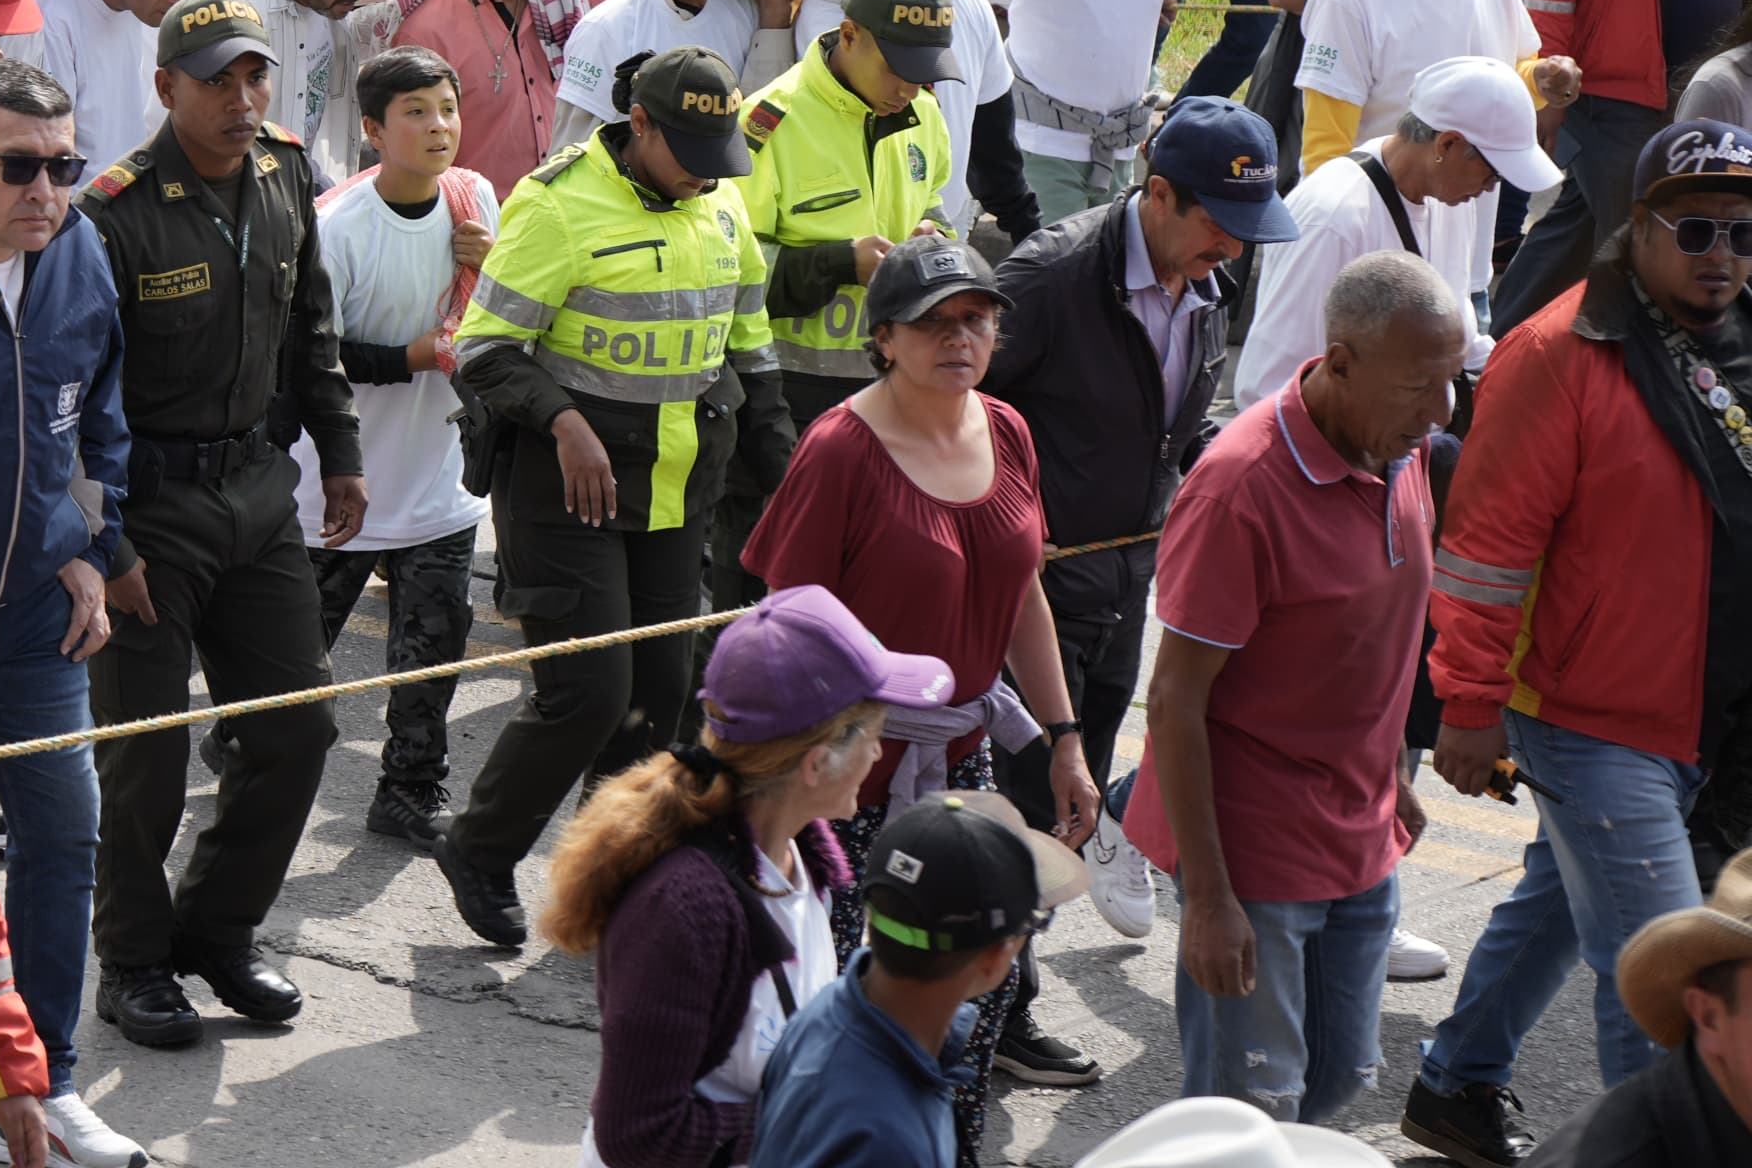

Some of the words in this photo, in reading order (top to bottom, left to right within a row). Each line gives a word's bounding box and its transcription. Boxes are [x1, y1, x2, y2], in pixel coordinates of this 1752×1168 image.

[181, 0, 262, 34] POLICIA
[583, 62, 602, 79] SAS
[144, 286, 179, 297] CARLOS
[180, 278, 206, 292] SALAS
